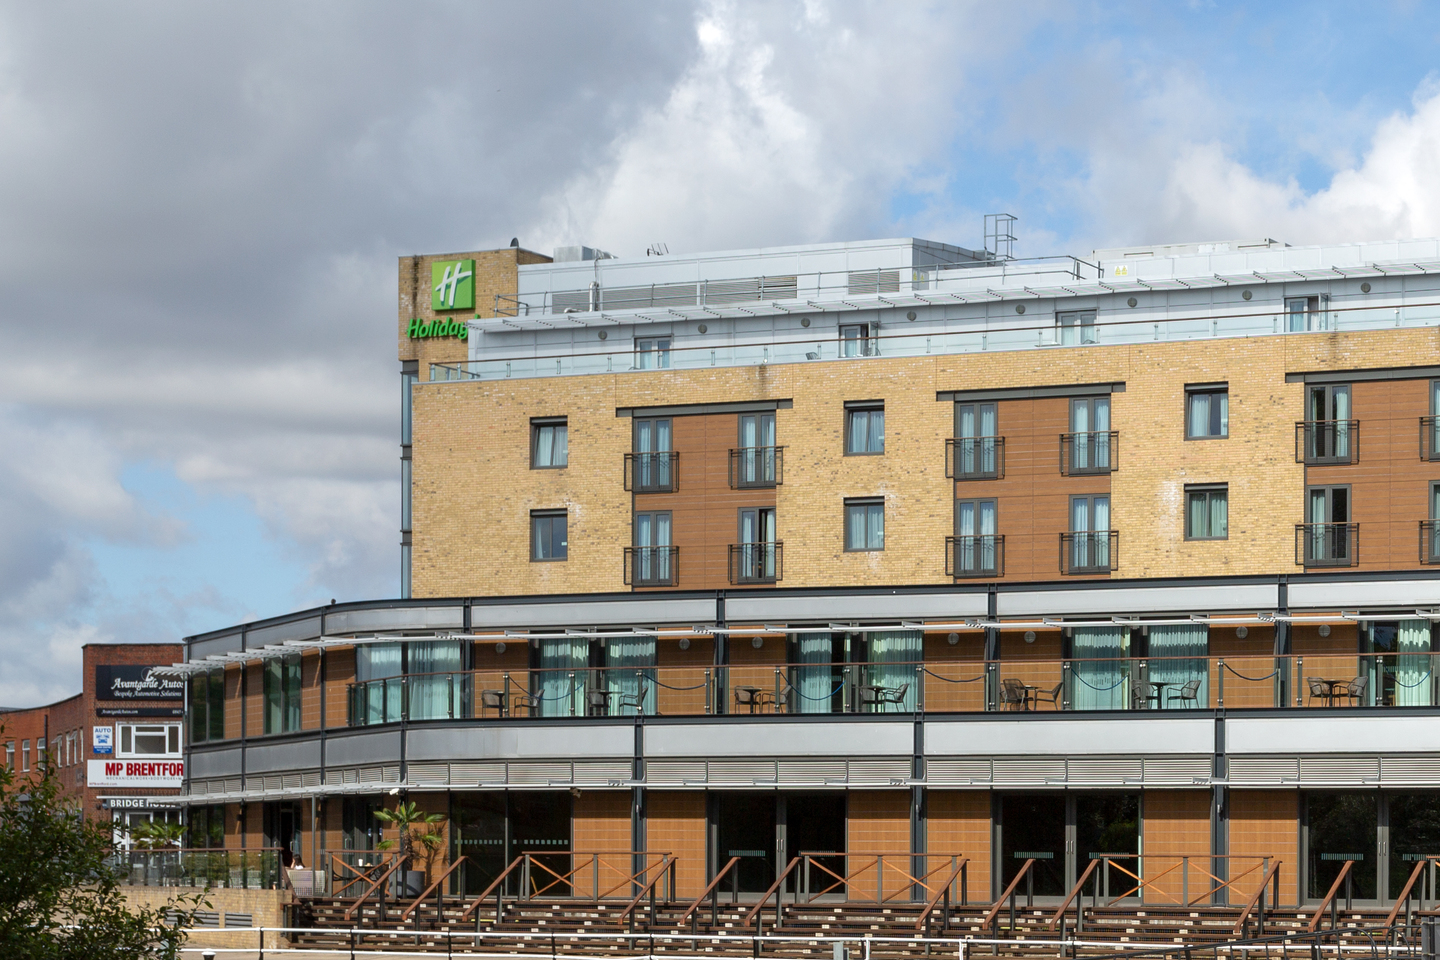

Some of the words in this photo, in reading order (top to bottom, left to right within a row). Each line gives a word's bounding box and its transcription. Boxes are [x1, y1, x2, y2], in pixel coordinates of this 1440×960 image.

[407, 317, 468, 340] Holiday
[111, 678, 159, 691] Avantgarde
[132, 690, 159, 698] Automotive
[159, 690, 182, 698] Solutions
[105, 762, 123, 776] MP
[110, 799, 144, 808] BRIDGE
